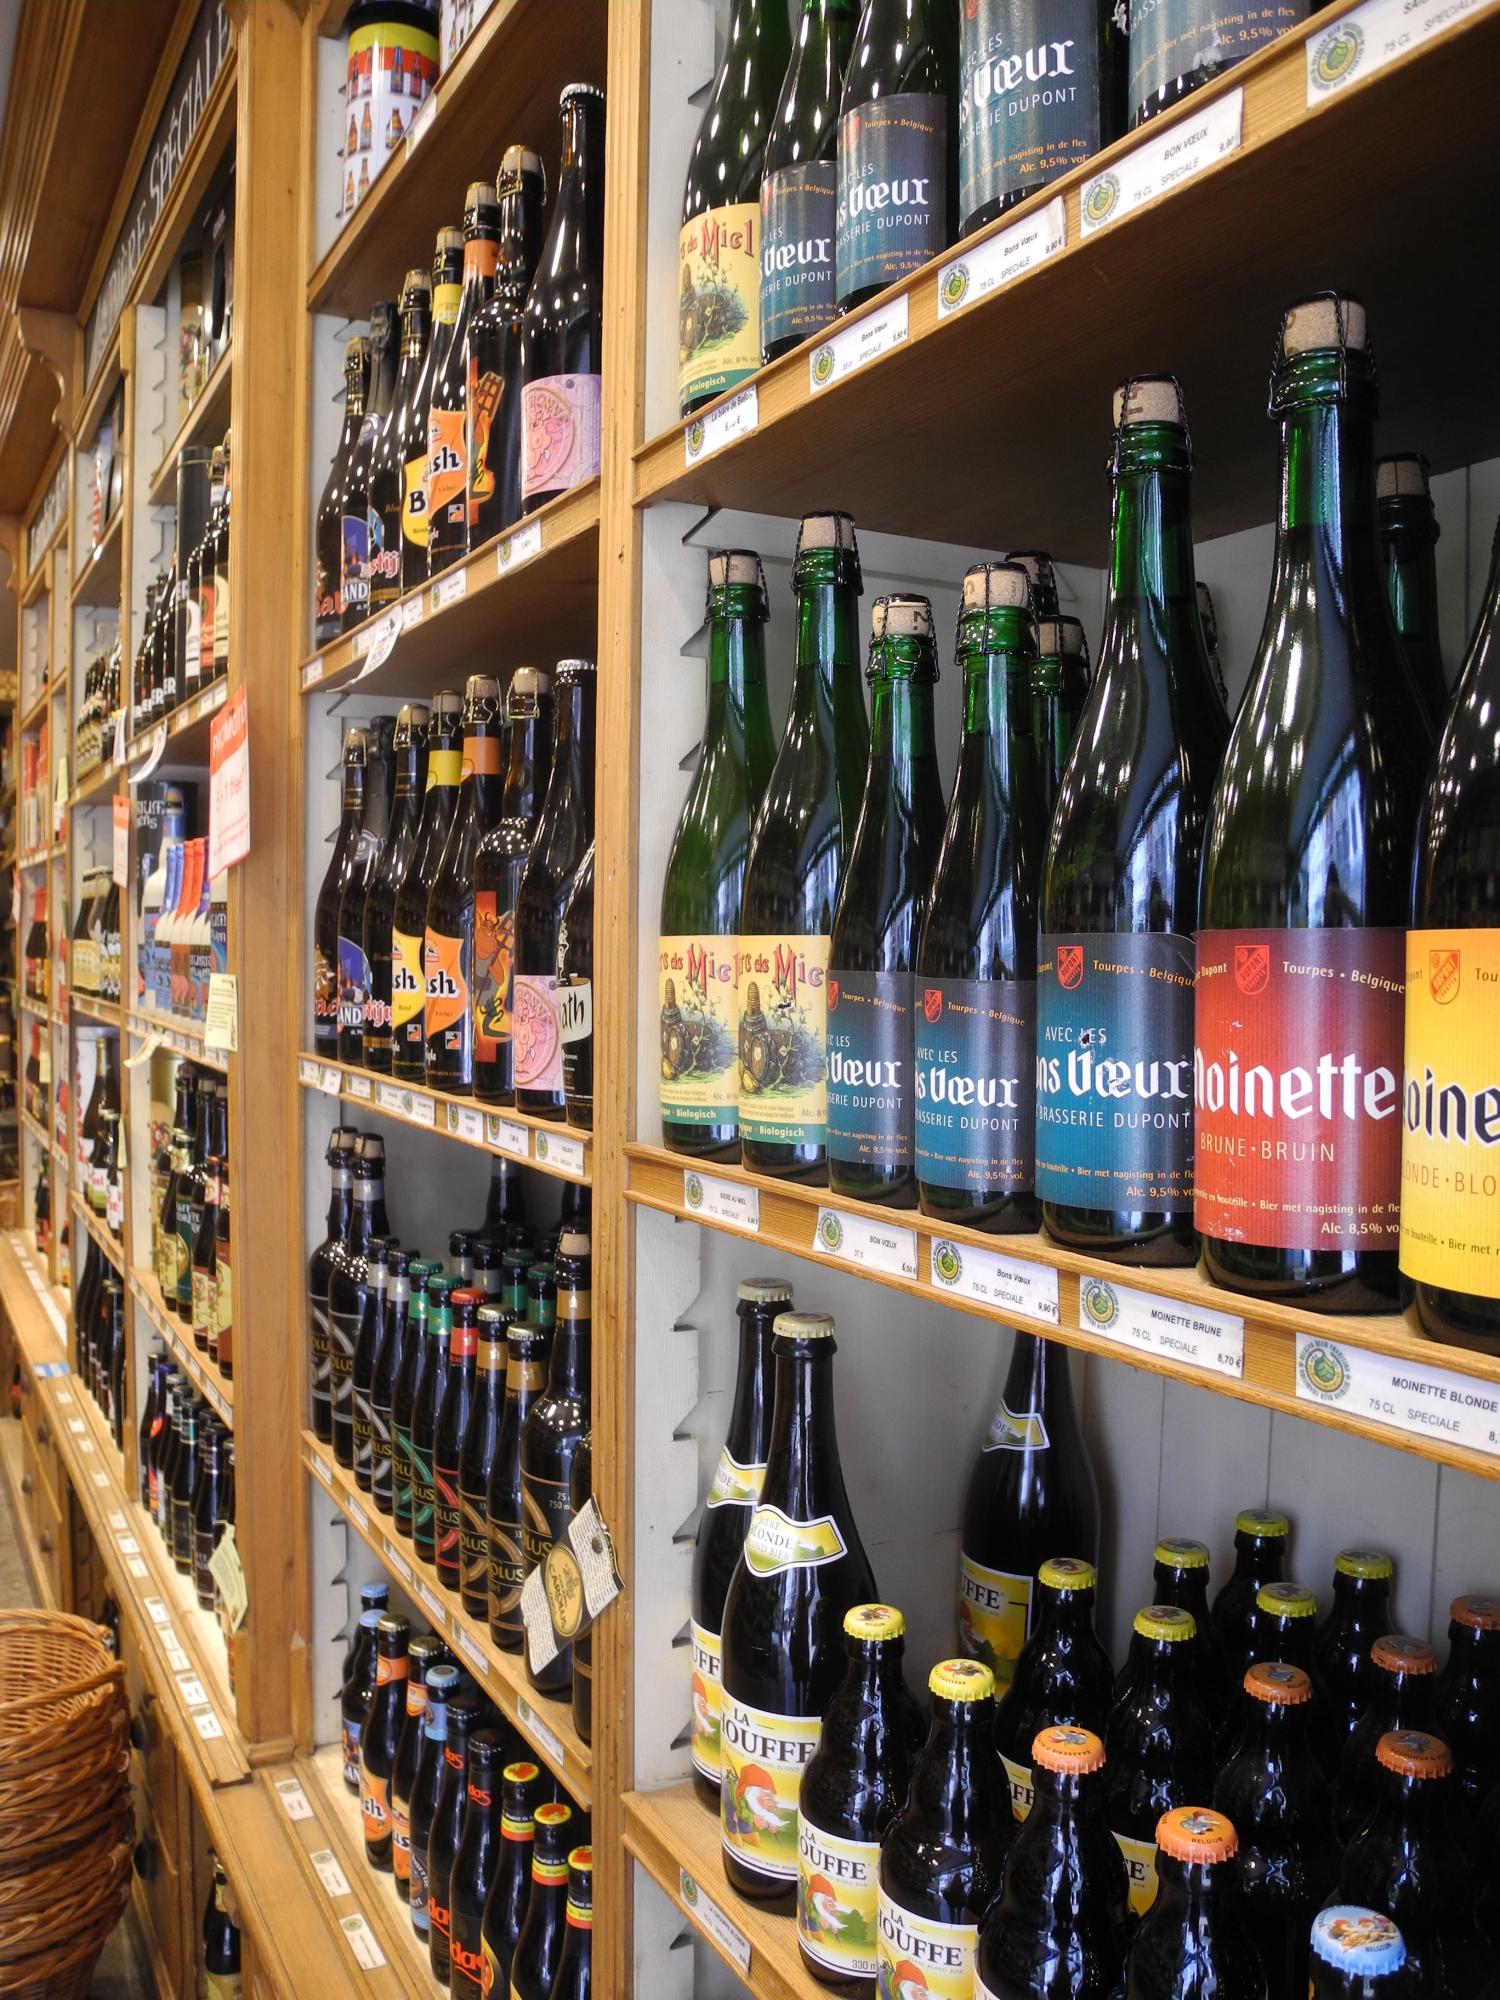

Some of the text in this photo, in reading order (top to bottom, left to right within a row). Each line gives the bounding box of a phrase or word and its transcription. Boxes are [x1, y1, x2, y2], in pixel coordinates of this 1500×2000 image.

[1180, 7, 1295, 42] met nagisting in de fles
[1214, 27, 1273, 46] Alc. 9,5%
[973, 40, 1075, 107] Vœux
[1008, 87, 1077, 117] DUPONT
[901, 118, 935, 133] Belgique
[1009, 138, 1087, 162] nagisting in de fles
[1164, 127, 1209, 161] BON VŒUX
[855, 162, 874, 180] LES
[1020, 157, 1067, 174] Alc. 9,5%
[1160, 157, 1200, 187] SPECIALE
[849, 178, 930, 218] Vœux
[877, 214, 930, 230] DUPONT
[700, 218, 754, 272] Miel
[764, 238, 831, 278] Vœux
[785, 270, 832, 289] DUPONT
[689, 375, 726, 396] Biologisch
[1093, 960, 1135, 976] Tourpes
[1240, 953, 1265, 982] DUPONT
[1201, 961, 1405, 993] Dupont Tourpes Belgique
[842, 991, 907, 1014] Tourpes Belgique
[948, 1001, 1025, 1027] Tourpes Belgique
[836, 1035, 850, 1048] LES
[1045, 1026, 1073, 1042] AVEC
[938, 1049, 958, 1064] LES
[830, 1051, 902, 1088] Vœux
[1068, 1049, 1190, 1100] Vœux
[930, 1067, 1019, 1109] Vœux
[853, 1095, 903, 1110] DUPONT
[676, 1109, 717, 1120] Biologisch
[1040, 1107, 1190, 1129] BRASSERIE DUPONT
[759, 1125, 805, 1138] Biologisch
[960, 1116, 1019, 1132] DUPONT
[859, 1144, 871, 1153] Alc.
[1200, 1132, 1335, 1163] BRUNE BRUIN
[991, 1158, 998, 1166] in
[1000, 1158, 1009, 1166] de
[1011, 1158, 1024, 1167] fles
[967, 1169, 1025, 1181] Alc. vol.
[1077, 1166, 1180, 1181] Bier met nagisting in de
[1126, 1187, 1180, 1198] Alc. 9,5%
[1217, 1194, 1384, 1216] bouteille Bier met nagisting in de
[1321, 1223, 1382, 1235] Alc. 8,5%
[870, 1235, 897, 1250] BON VŒUX
[1449, 1238, 1490, 1256] Bier met
[997, 1268, 1031, 1286] Bons Vœux
[973, 1282, 1051, 1313] 75 CL SPECIALE 9,90
[1151, 1309, 1222, 1338] MOINETTE BRUNE
[1132, 1327, 1241, 1368] 75 CL SPECIALE 8,70 €
[1391, 1376, 1499, 1412] MOINETTE BLONDE
[1368, 1398, 1461, 1432] 75 CL SPECIALE
[550, 1500, 562, 1510] 750
[557, 1492, 567, 1501] 75
[768, 1546, 791, 1561] BIER
[734, 1708, 751, 1727] LA
[805, 1828, 816, 1844] LA
[1192, 1836, 1223, 1845] BELGIUM
[890, 1909, 904, 1927] LA
[852, 1959, 869, 1970] 330
